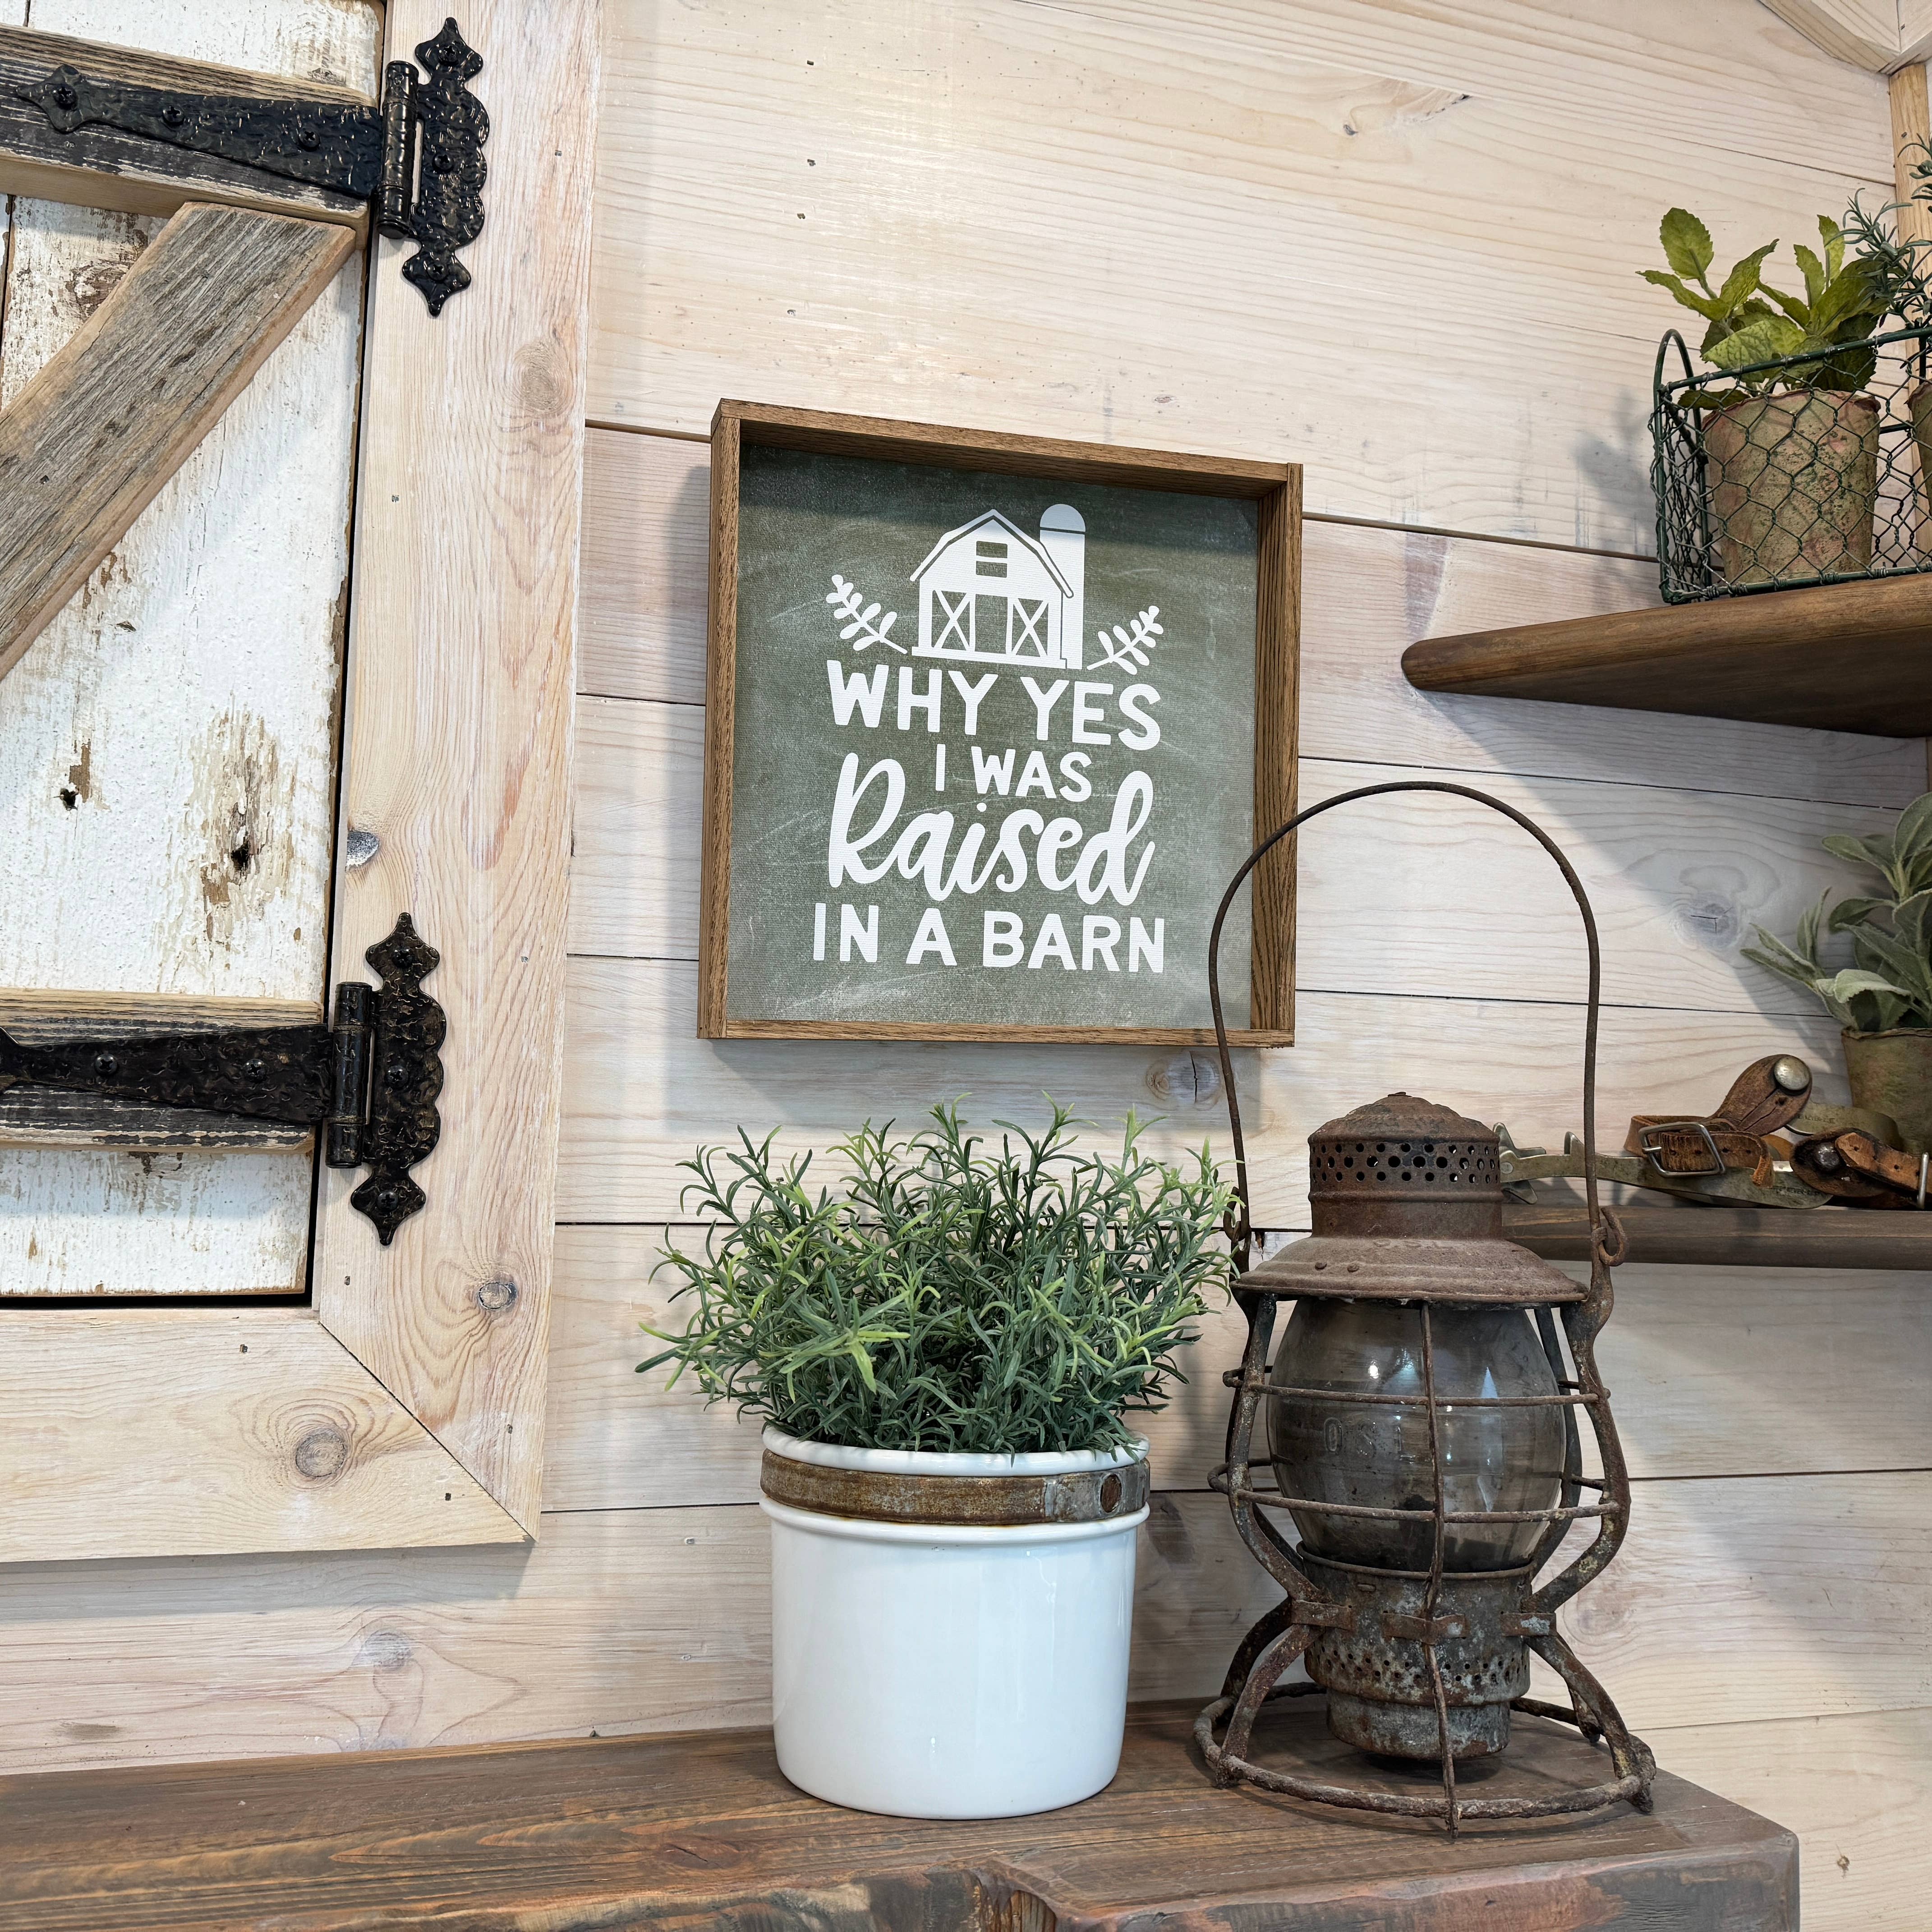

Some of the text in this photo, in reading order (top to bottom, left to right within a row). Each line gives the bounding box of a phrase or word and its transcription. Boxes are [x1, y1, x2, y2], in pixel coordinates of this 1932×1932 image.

[826, 659, 1161, 751] WHY YES
[935, 743, 1092, 803] I WAS
[828, 752, 1156, 906] Raised
[813, 902, 1165, 974] IN A BARN
